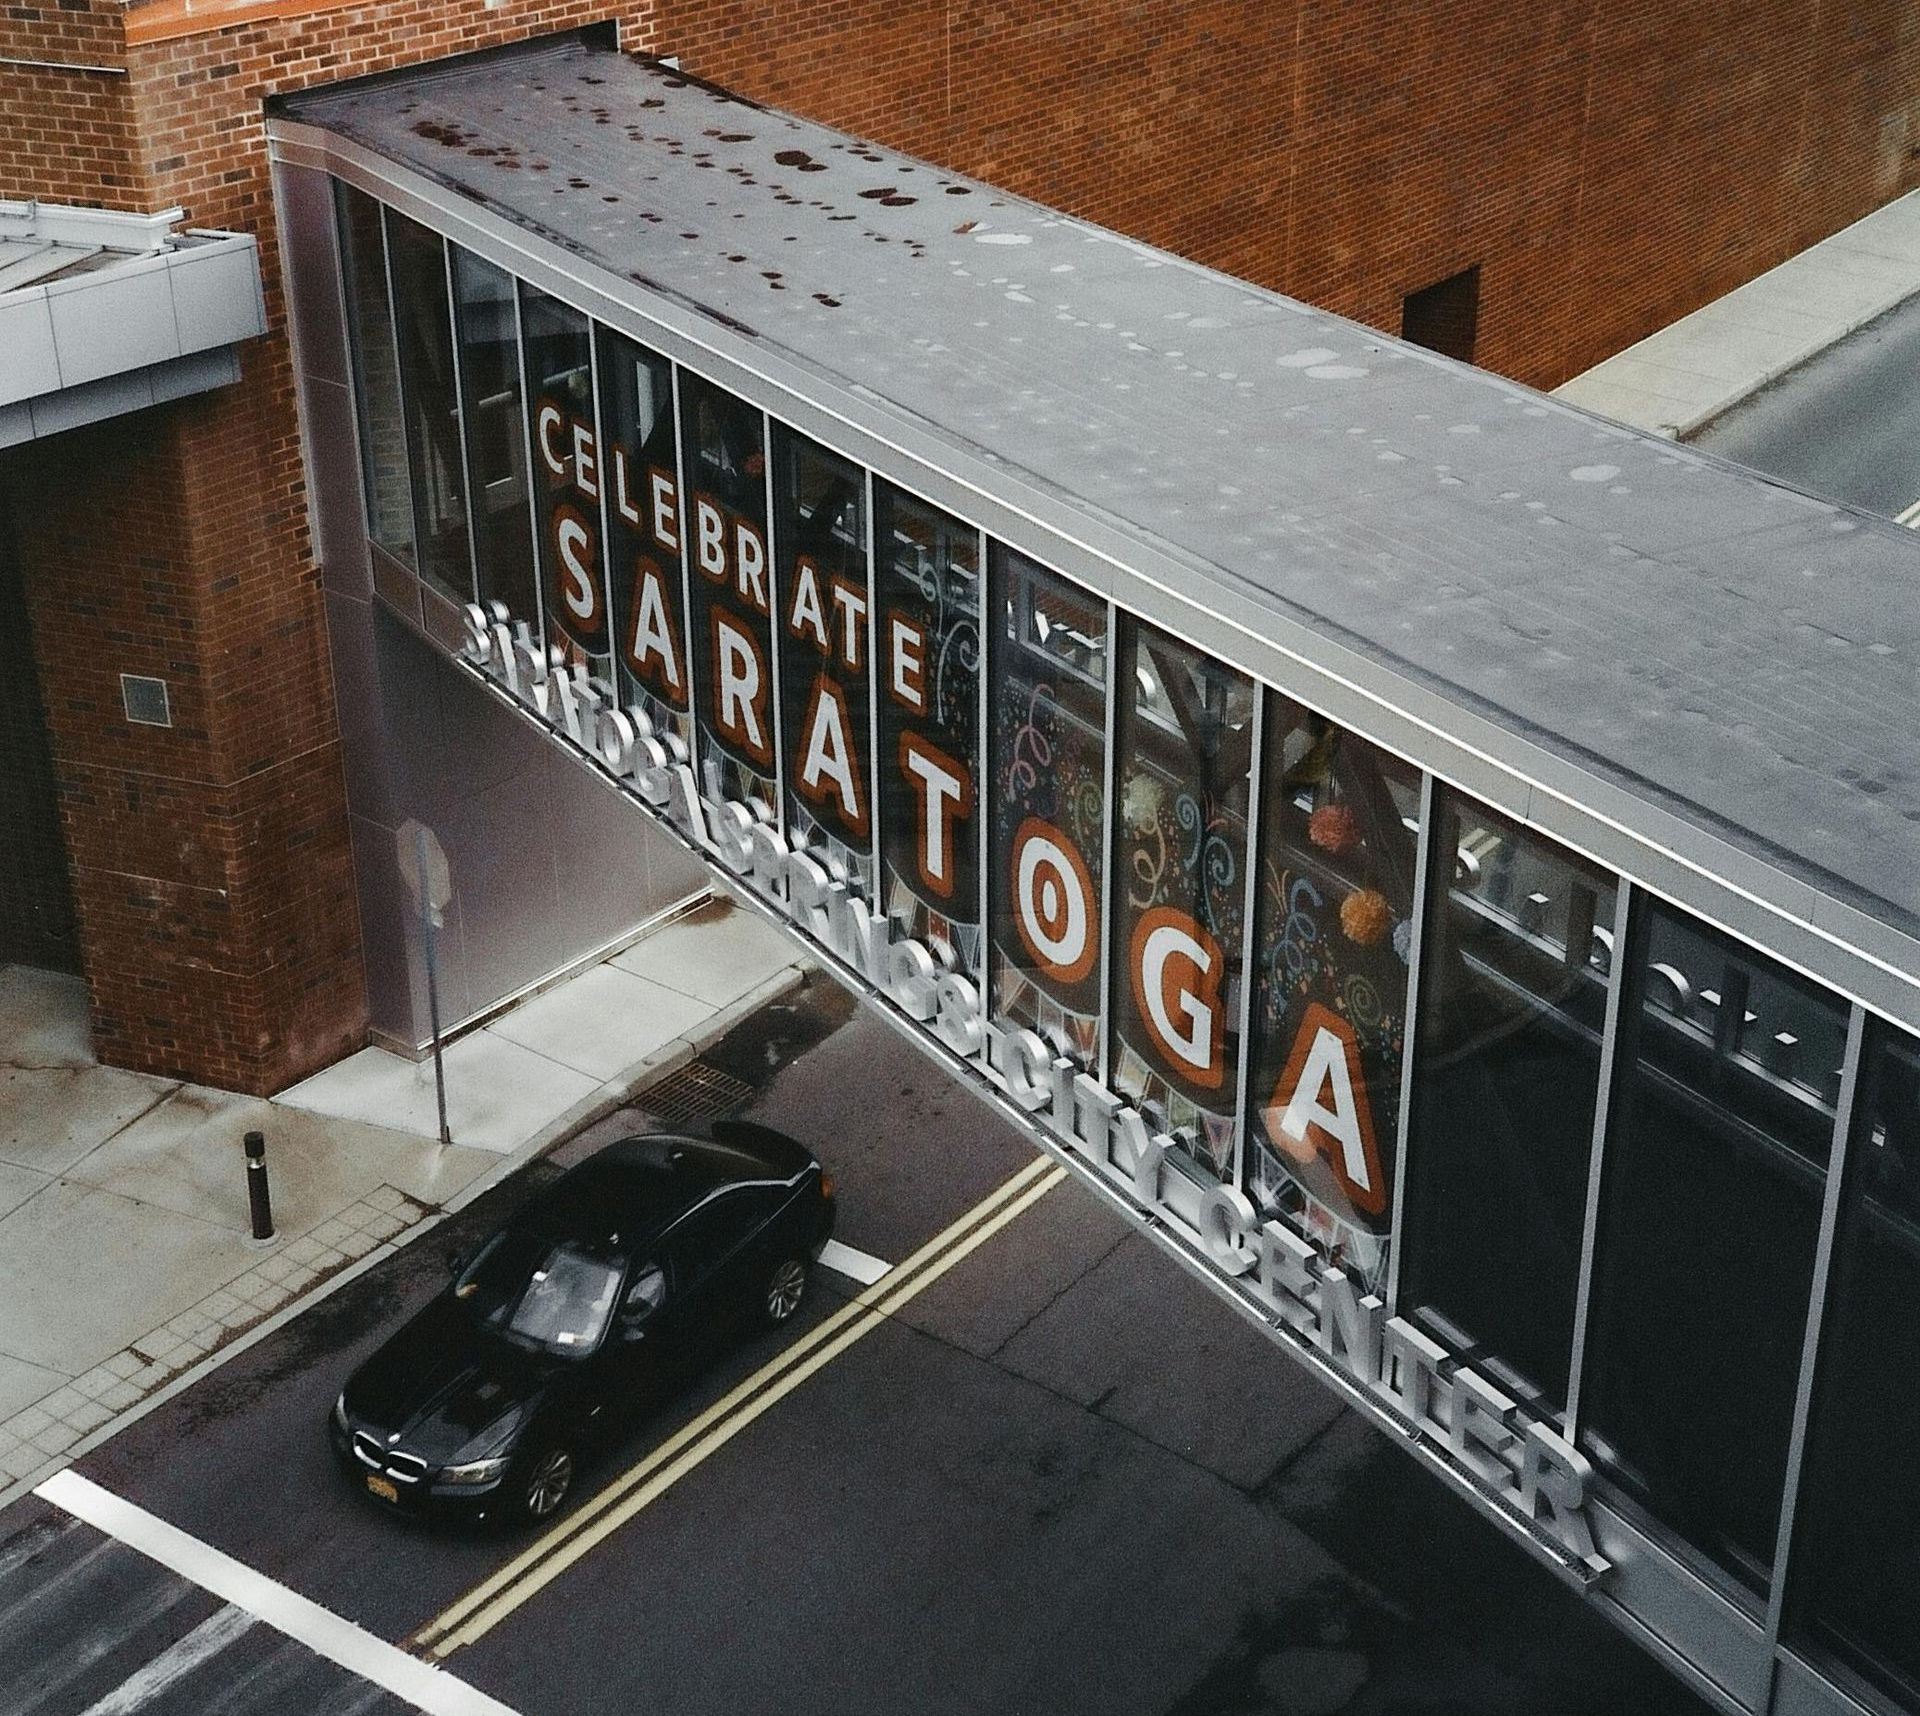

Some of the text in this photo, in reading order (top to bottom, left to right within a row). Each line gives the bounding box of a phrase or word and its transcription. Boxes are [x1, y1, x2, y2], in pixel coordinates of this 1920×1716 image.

[539, 405, 922, 708] CELEBRATE
[558, 518, 1371, 1194] SARATOGA
[718, 800, 983, 1056] SPRINGS
[1002, 1028, 1176, 1204] CITY
[1200, 1183, 1612, 1572] CENTER
